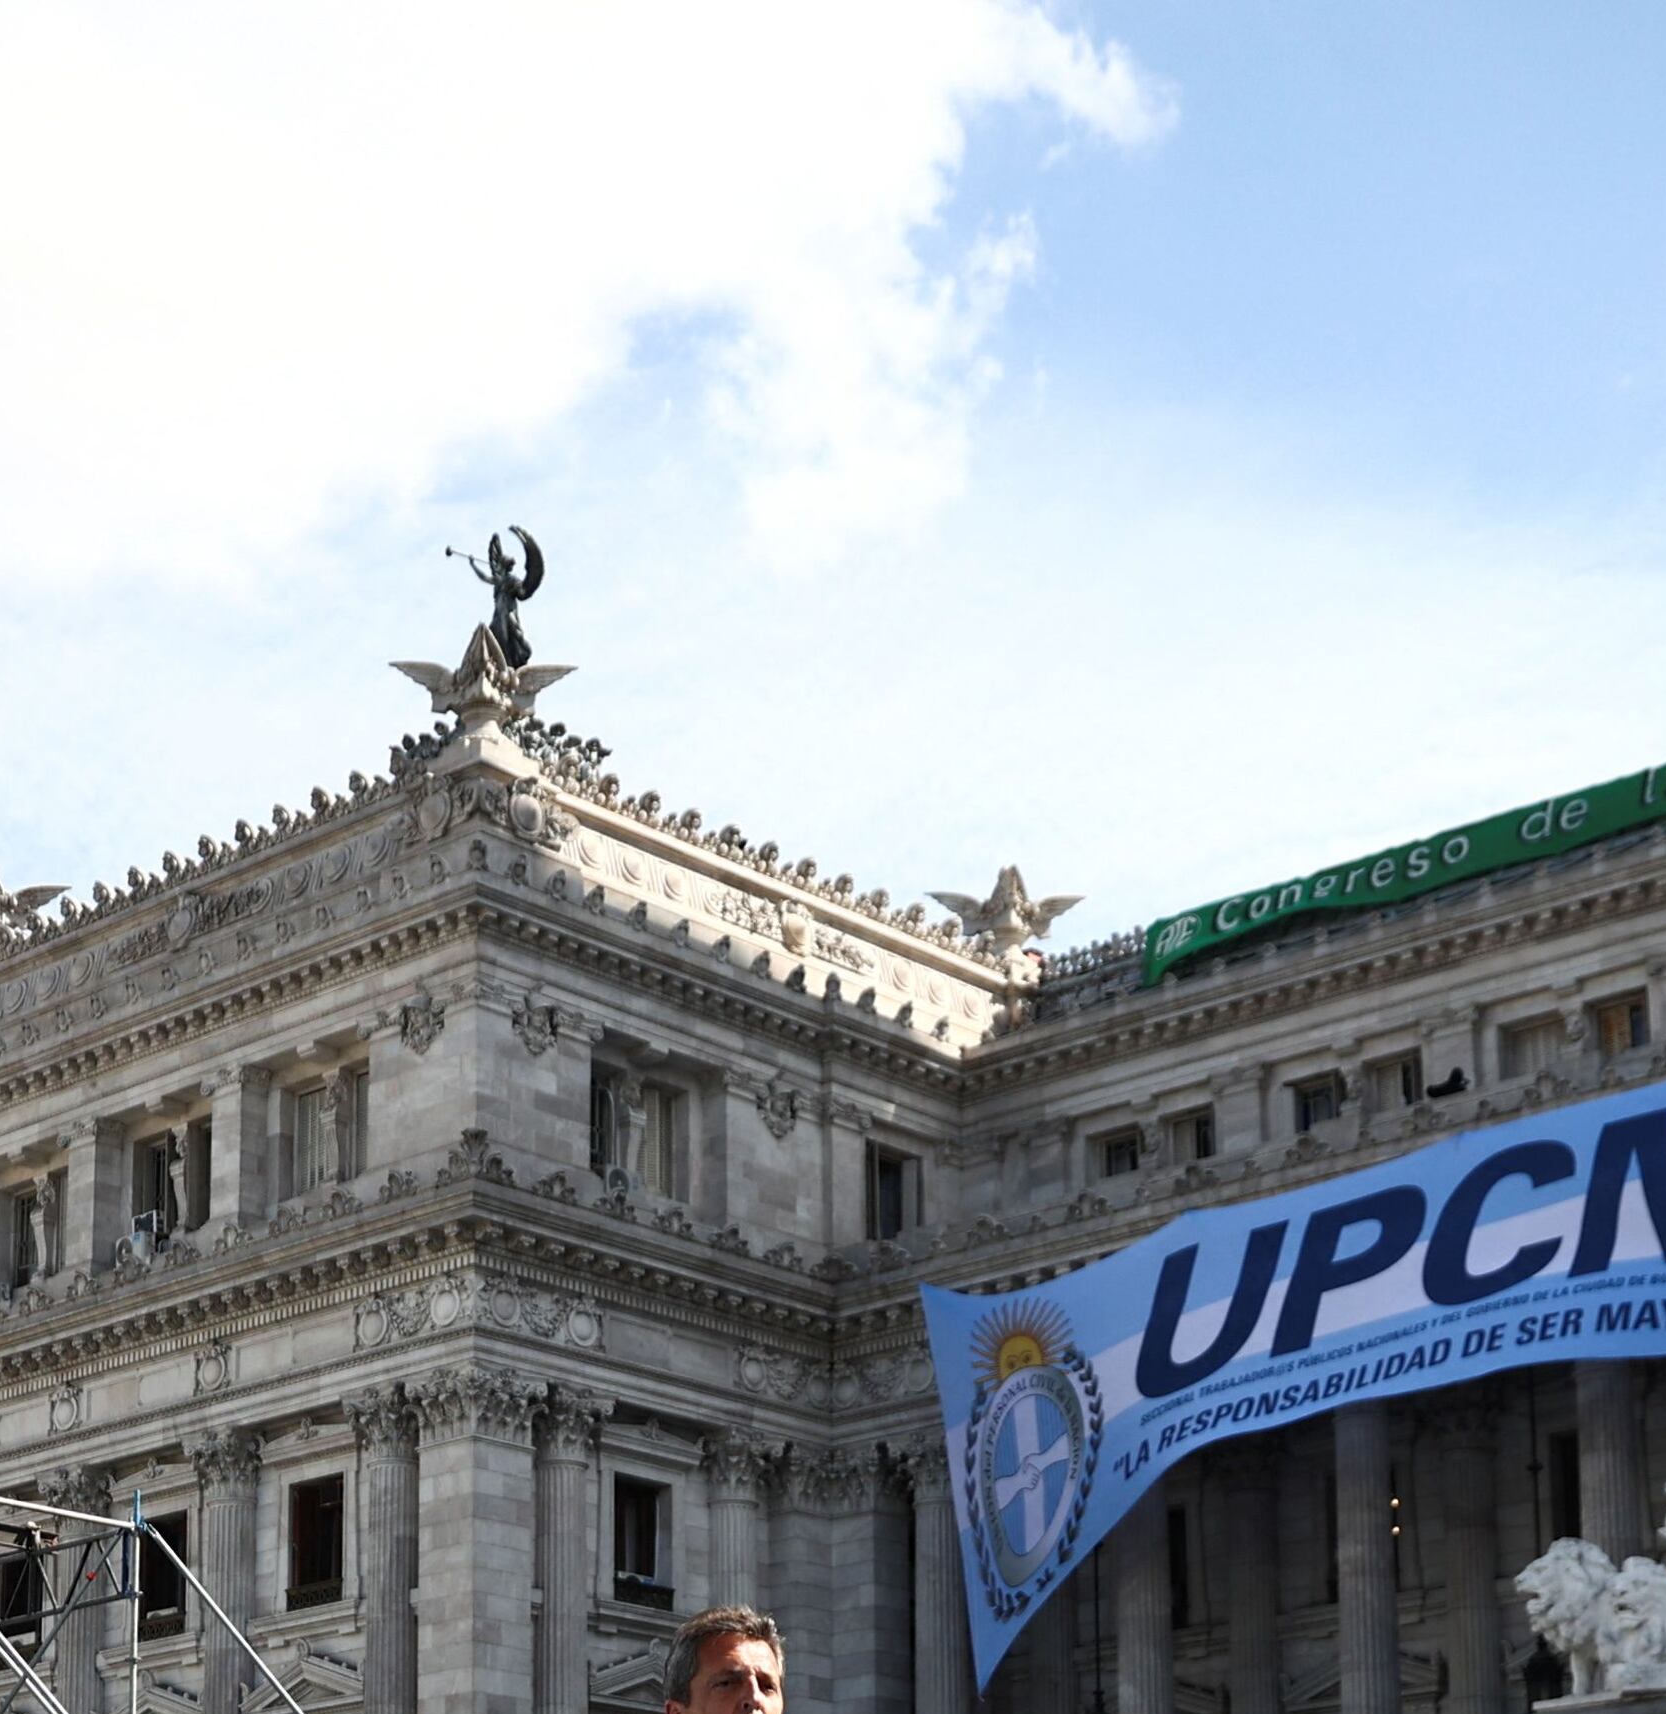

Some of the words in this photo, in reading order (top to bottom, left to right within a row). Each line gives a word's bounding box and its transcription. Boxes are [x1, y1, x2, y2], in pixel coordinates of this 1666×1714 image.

[1215, 835, 1470, 932] Congreso
[1520, 799, 1590, 841] de
[1356, 1320, 1428, 1353] NACIONALES
[1441, 1310, 1462, 1326] DEL
[1465, 1293, 1530, 1319] GOBIERNO
[1531, 1289, 1549, 1302] DE
[1552, 1286, 1570, 1299] LA
[1572, 1276, 1626, 1296] CIUDAD
[1628, 1274, 1646, 1287] DE
[1157, 1336, 1452, 1454] RESPONSABILIDAD
[1461, 1322, 1507, 1359] DE
[1515, 1307, 1583, 1347] SER
